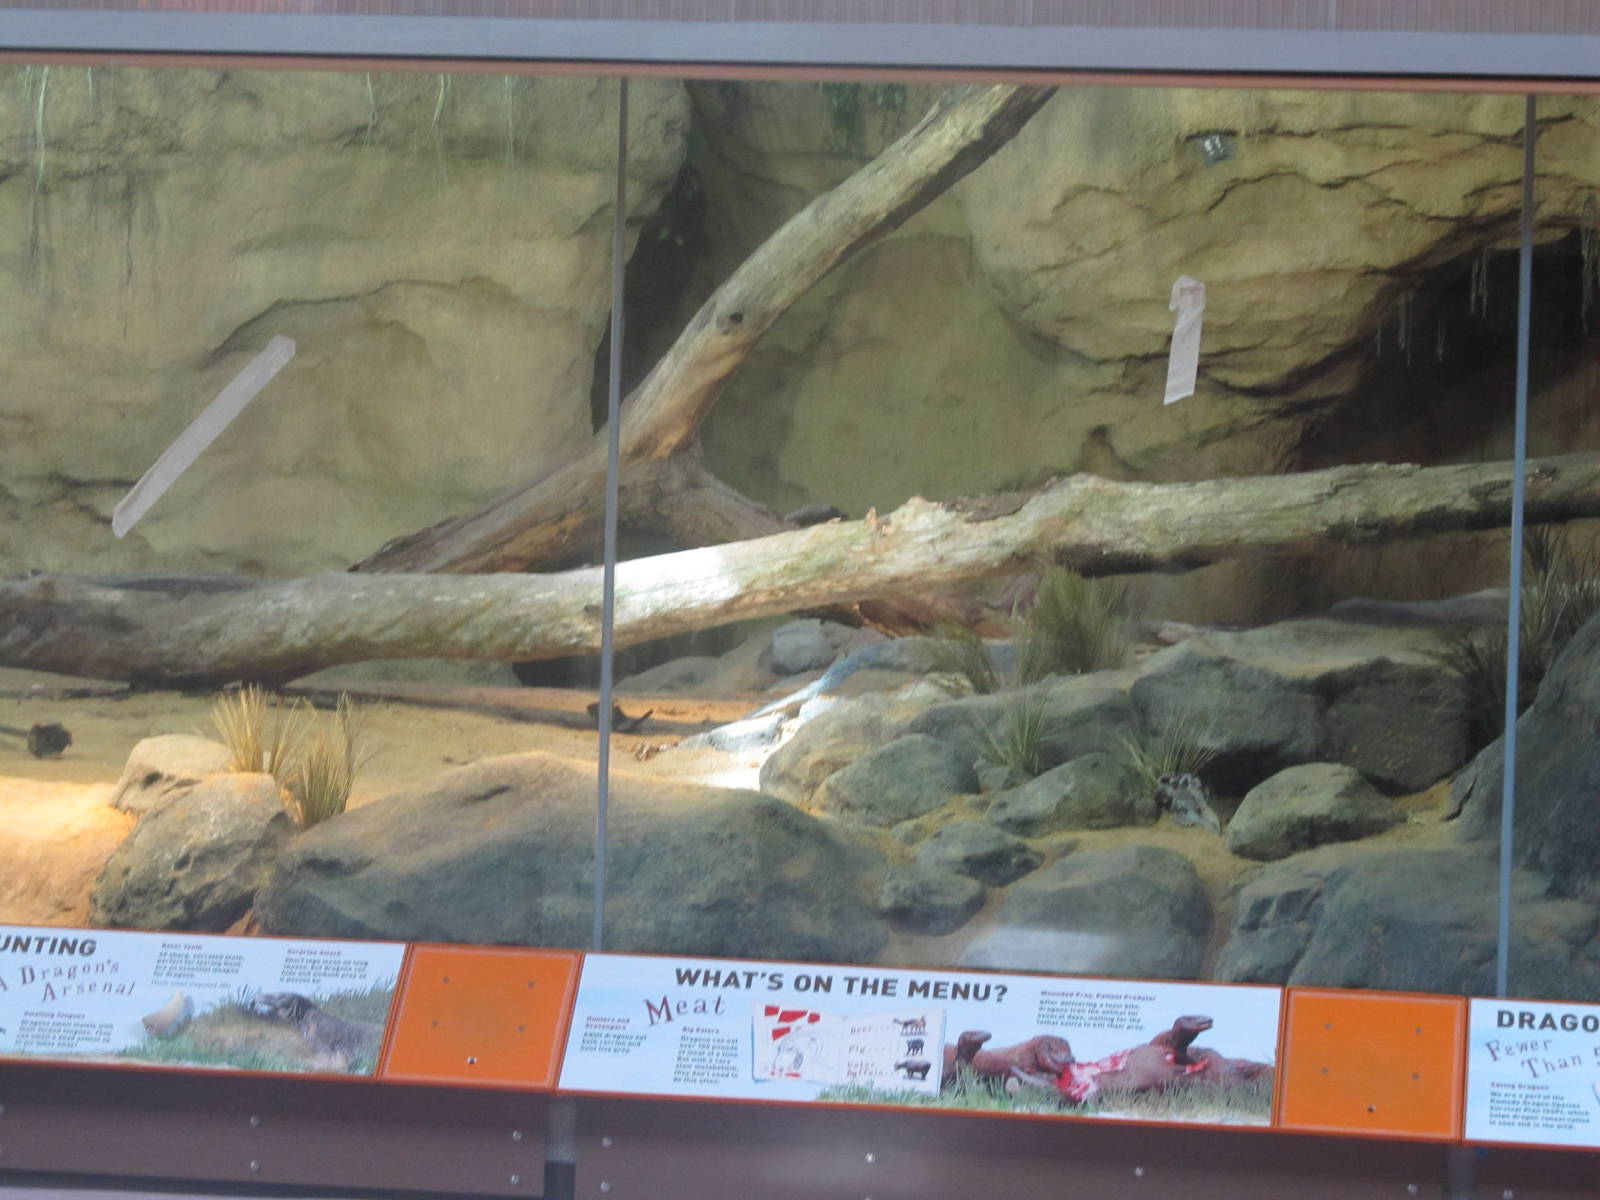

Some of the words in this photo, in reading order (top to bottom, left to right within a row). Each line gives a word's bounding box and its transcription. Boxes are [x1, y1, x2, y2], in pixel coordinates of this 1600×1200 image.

[0, 934, 97, 956] UNTING
[0, 976, 8, 991] A
[20, 958, 119, 984] Dragon's
[674, 968, 784, 992] WHAT'S
[794, 974, 833, 994] ON
[843, 976, 900, 997] THE
[907, 980, 1008, 1003] MENU?
[41, 982, 136, 1002] Arsenal
[643, 994, 727, 1027] Meat
[1497, 1010, 1600, 1033] DRAGO
[1484, 1038, 1552, 1062] Fewer
[1520, 1054, 1583, 1078] Than
